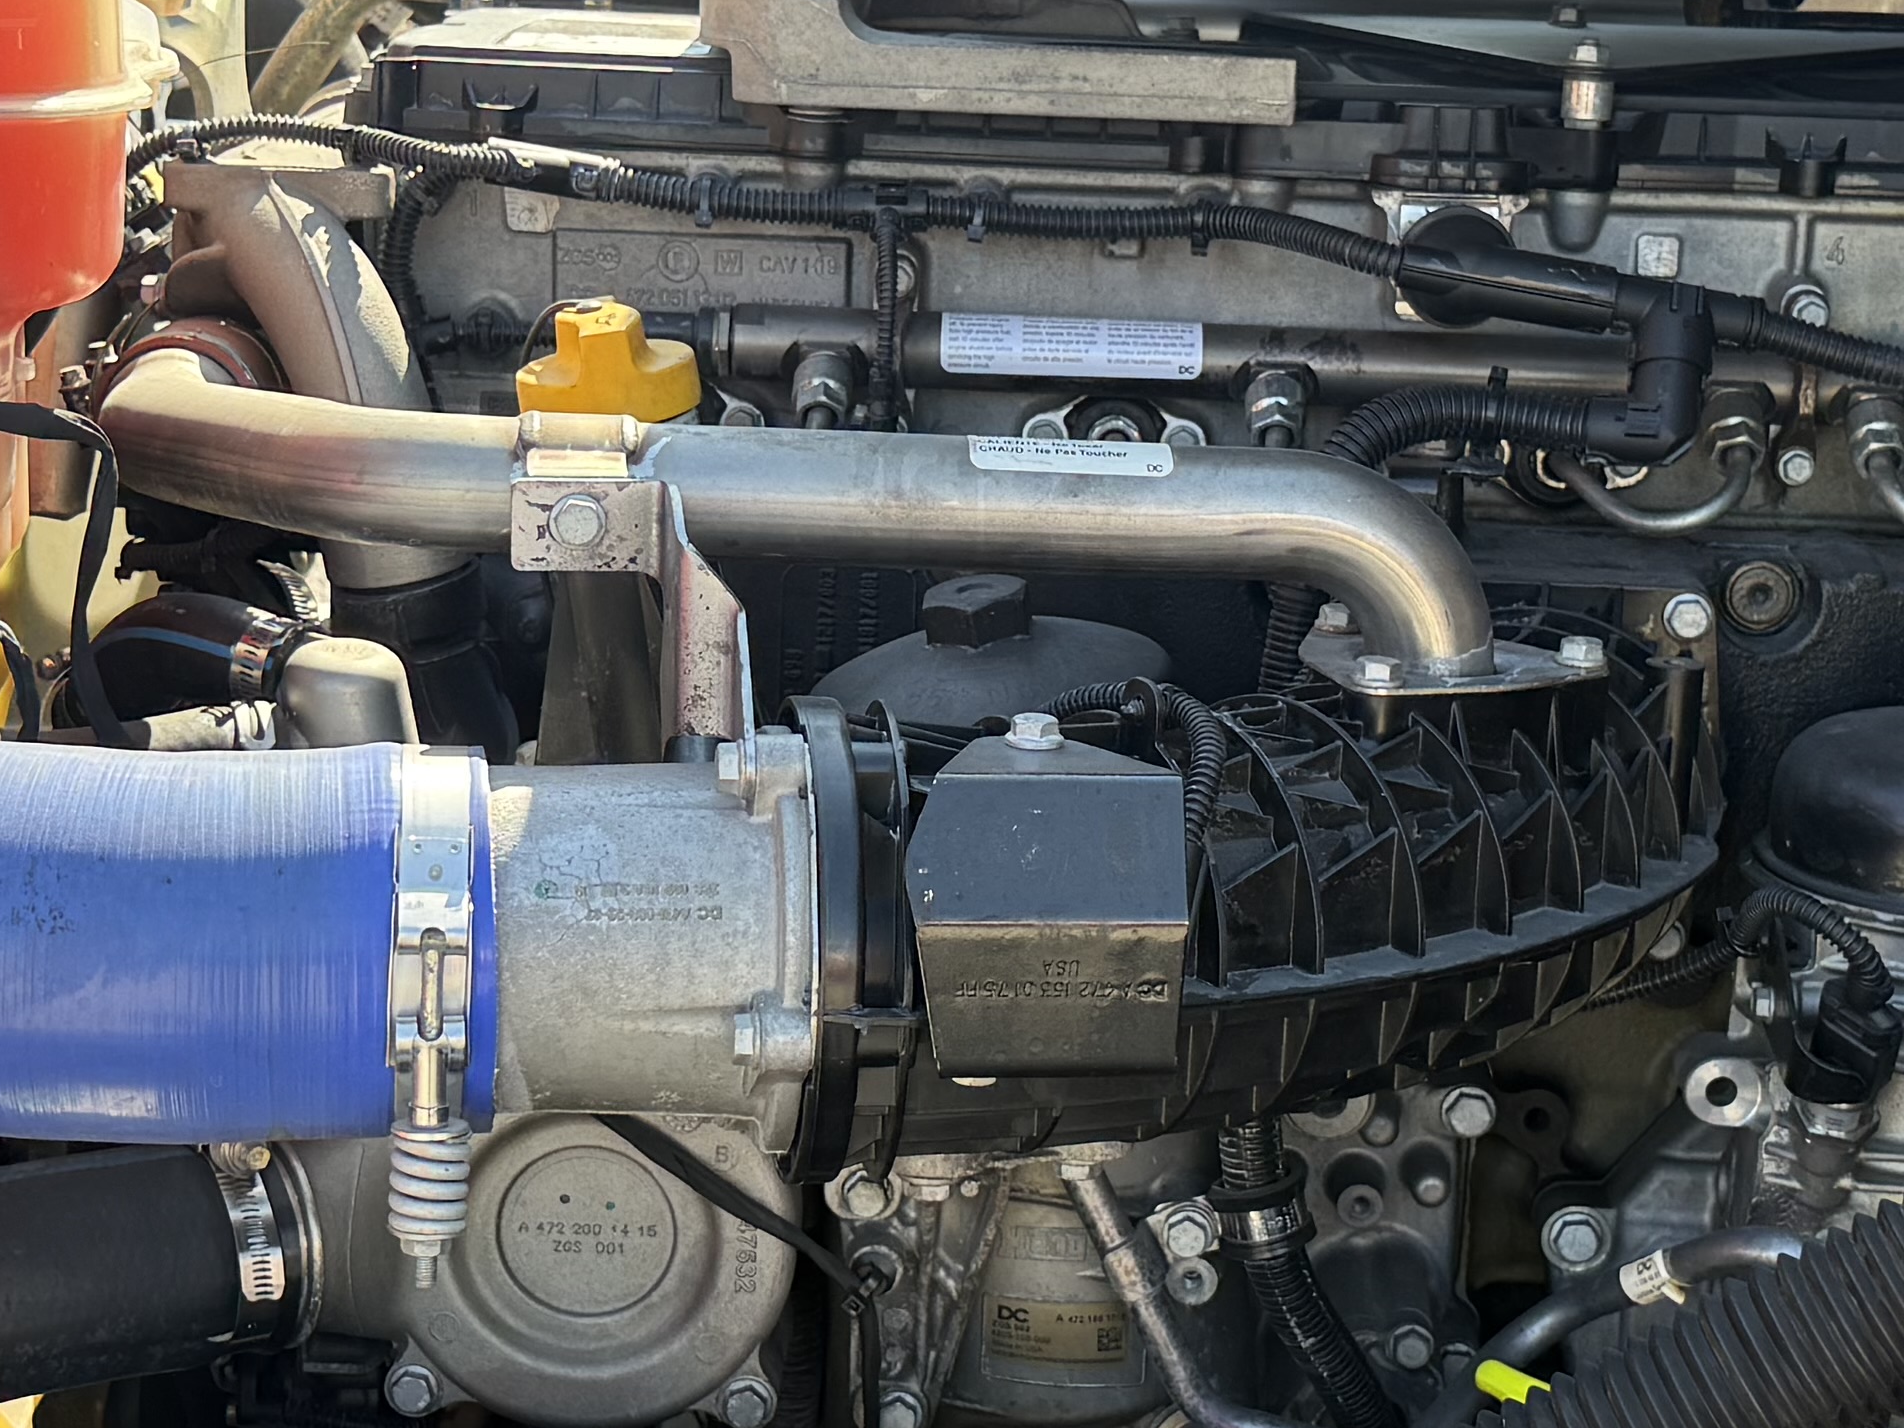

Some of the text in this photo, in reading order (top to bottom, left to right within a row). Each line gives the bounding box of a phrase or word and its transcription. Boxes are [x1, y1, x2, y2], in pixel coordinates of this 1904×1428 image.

[1179, 366, 1194, 375] DC
[979, 445, 1024, 454] CHAUD
[1055, 448, 1077, 457] Pas
[1080, 450, 1128, 459] Toucher
[1147, 464, 1163, 472] DC
[1042, 959, 1081, 976] USA
[536, 1223, 565, 1235] 472
[572, 1223, 602, 1236] 200
[637, 1225, 658, 1238] 15
[552, 1240, 625, 1255] ZGS 001
[997, 1304, 1029, 1323] DC
